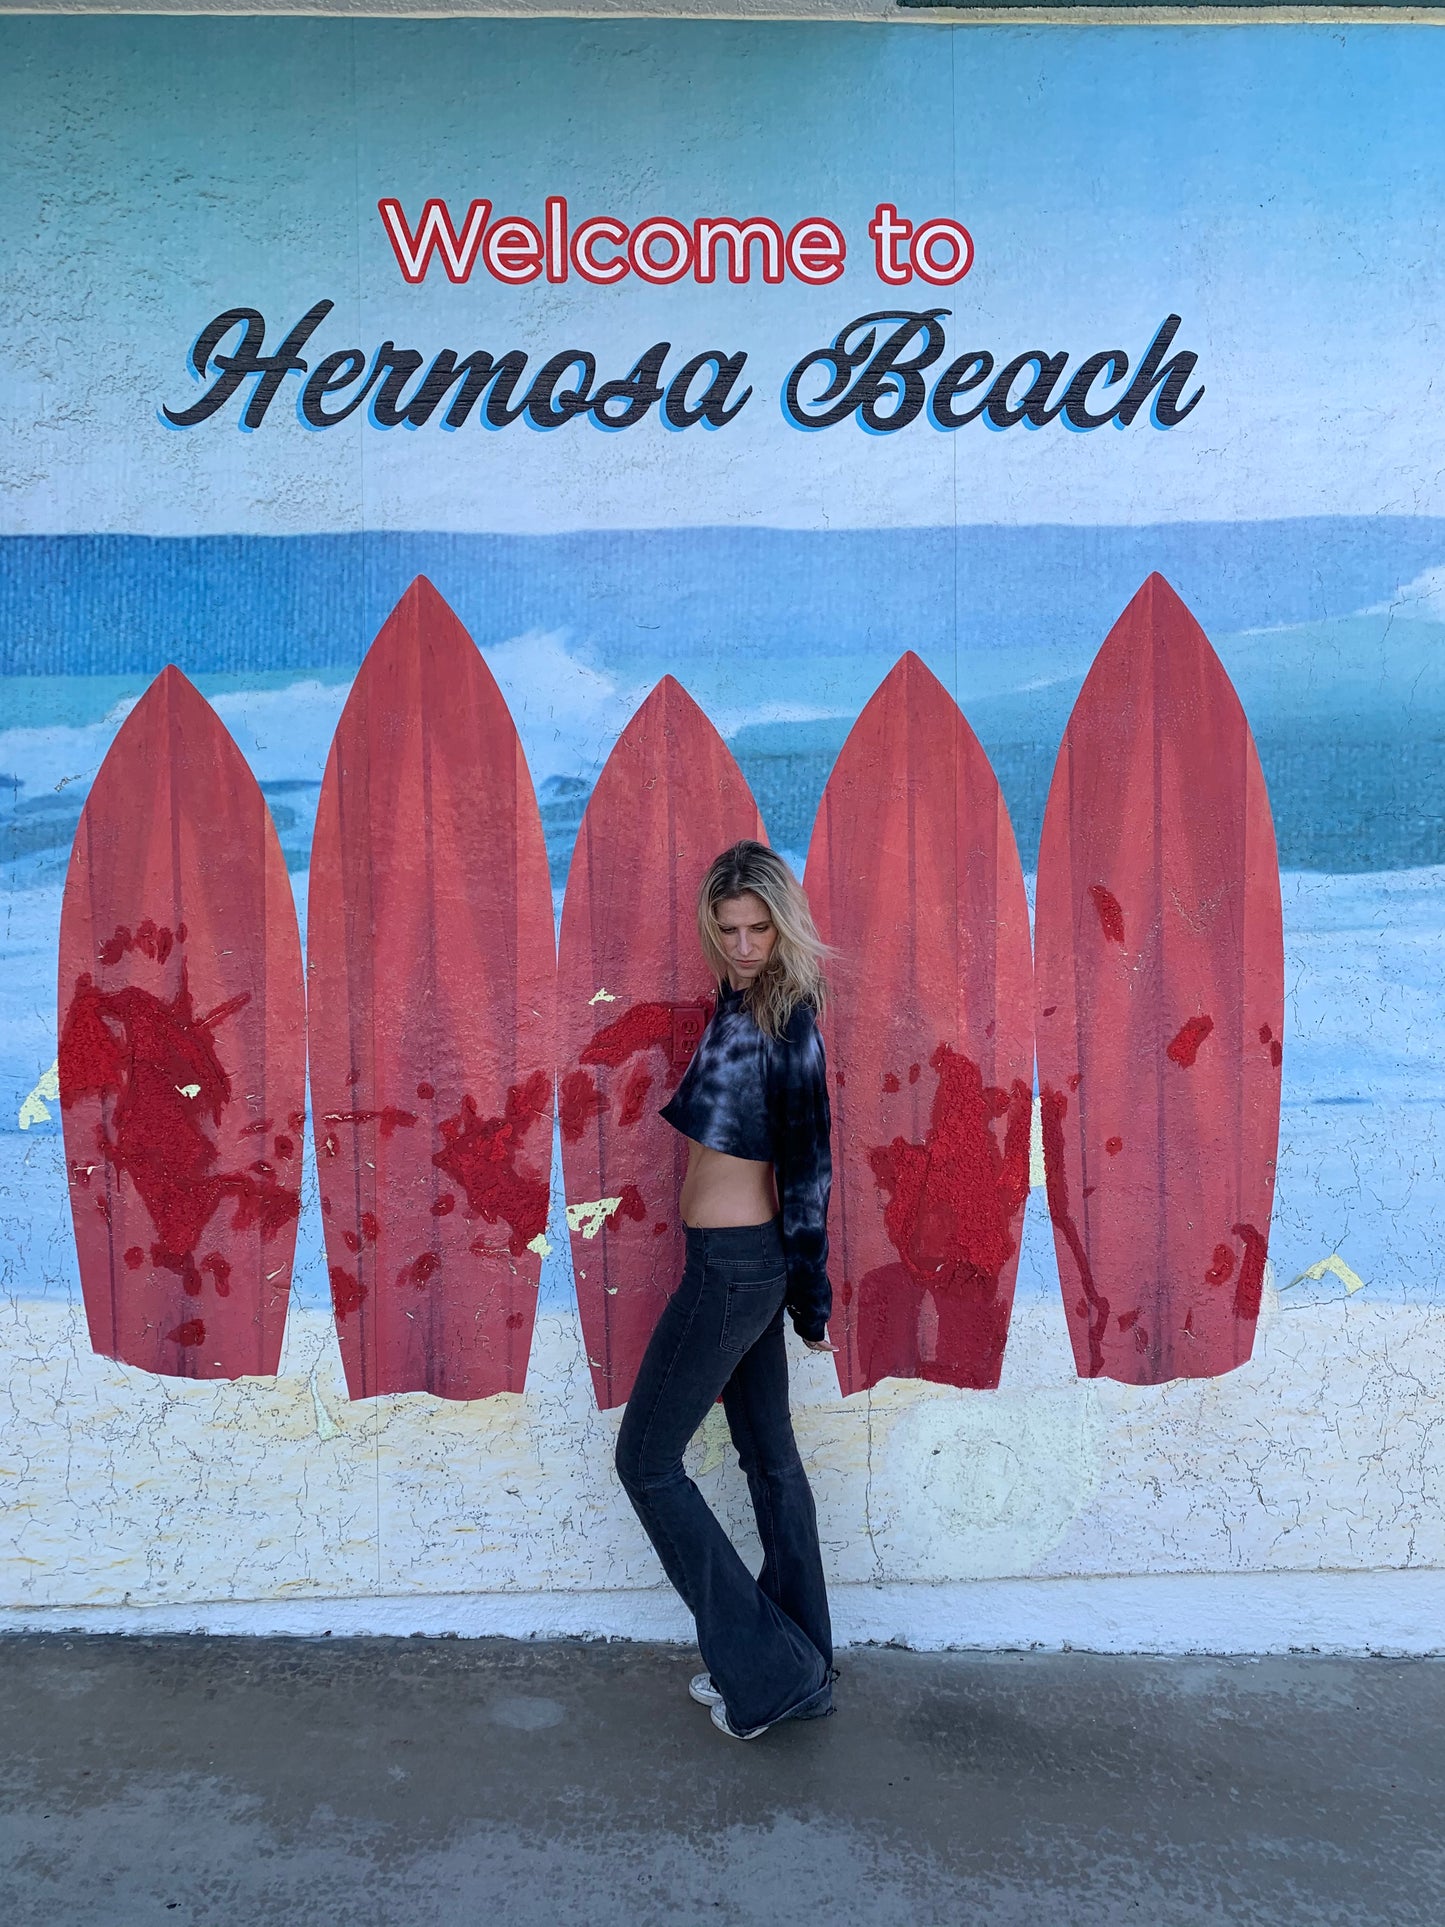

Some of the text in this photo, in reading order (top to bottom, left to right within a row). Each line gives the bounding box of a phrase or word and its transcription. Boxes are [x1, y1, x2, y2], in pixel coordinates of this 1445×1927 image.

[377, 196, 975, 286] Welcome to
[157, 299, 1205, 435] Hermosa Beach
